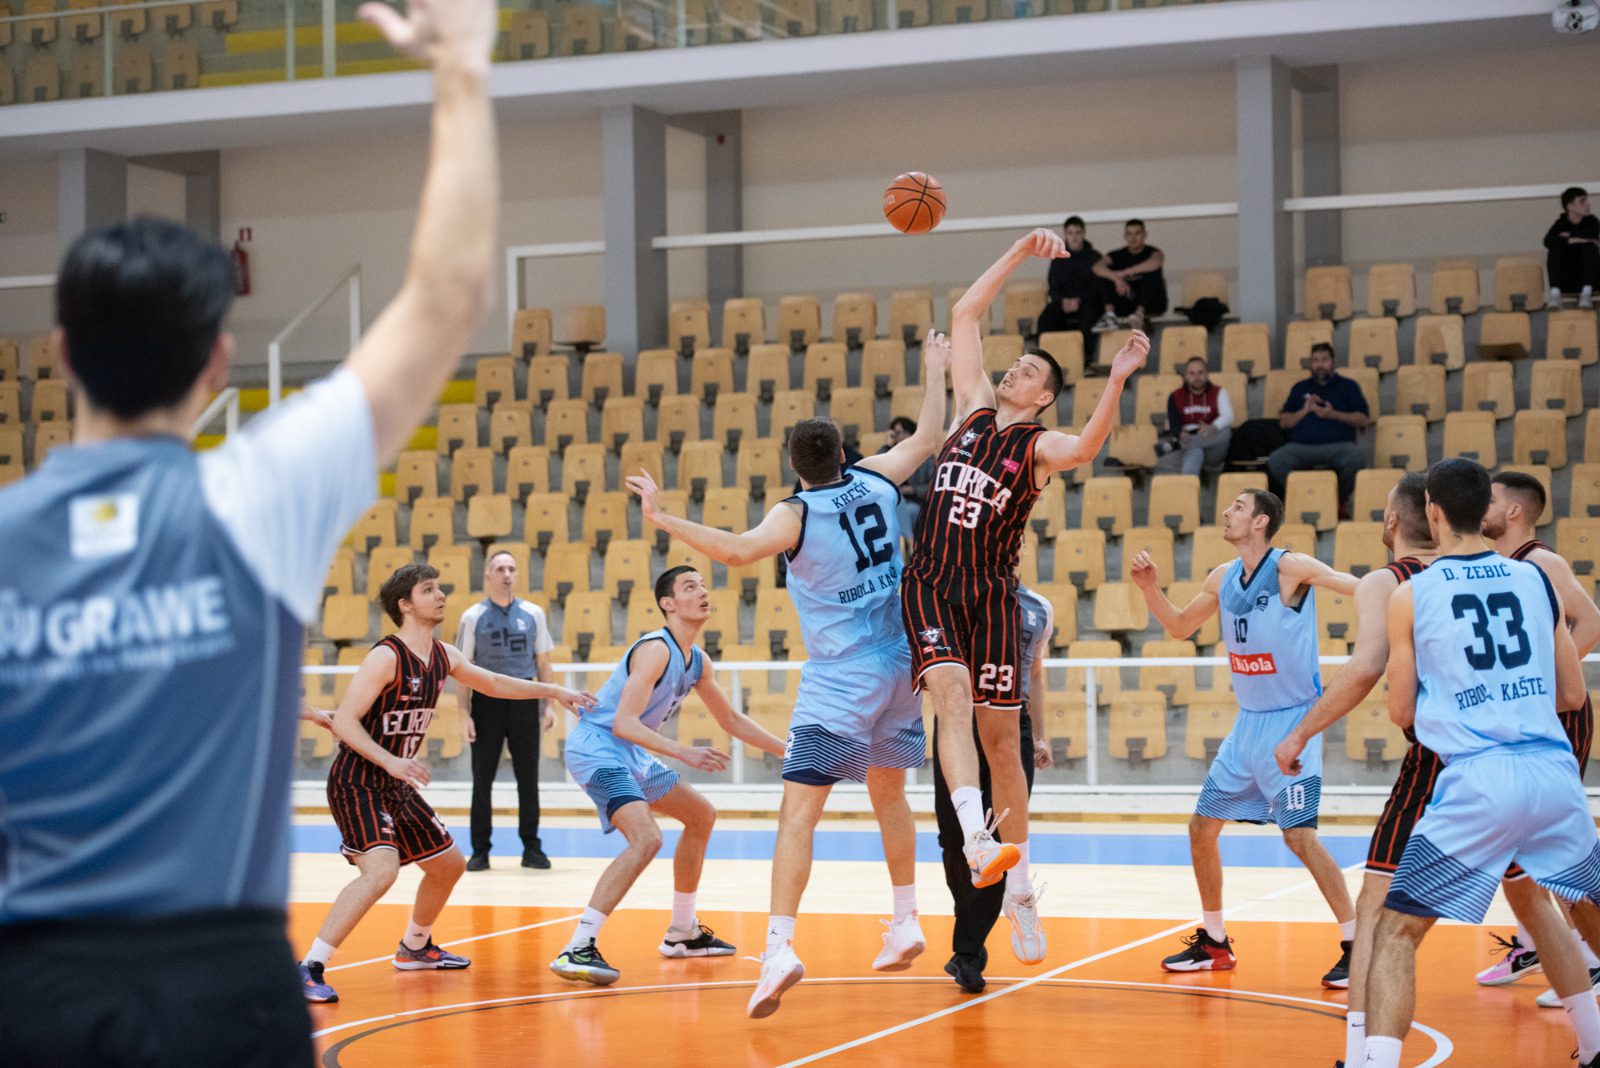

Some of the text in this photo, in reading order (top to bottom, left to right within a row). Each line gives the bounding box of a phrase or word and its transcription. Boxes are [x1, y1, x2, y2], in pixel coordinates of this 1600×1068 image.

[935, 461, 1013, 516] GORICA
[948, 495, 982, 529] 23
[839, 502, 894, 574] 12
[1442, 562, 1512, 581] D. ZEBIĆ
[838, 579, 876, 604] RIBOLA
[46, 576, 230, 657] GRAWE
[1234, 618, 1248, 643] 10
[1451, 591, 1532, 671] 33
[979, 663, 1014, 692] 23
[1501, 675, 1549, 702] KAŠTE
[1286, 783, 1306, 811] 10
